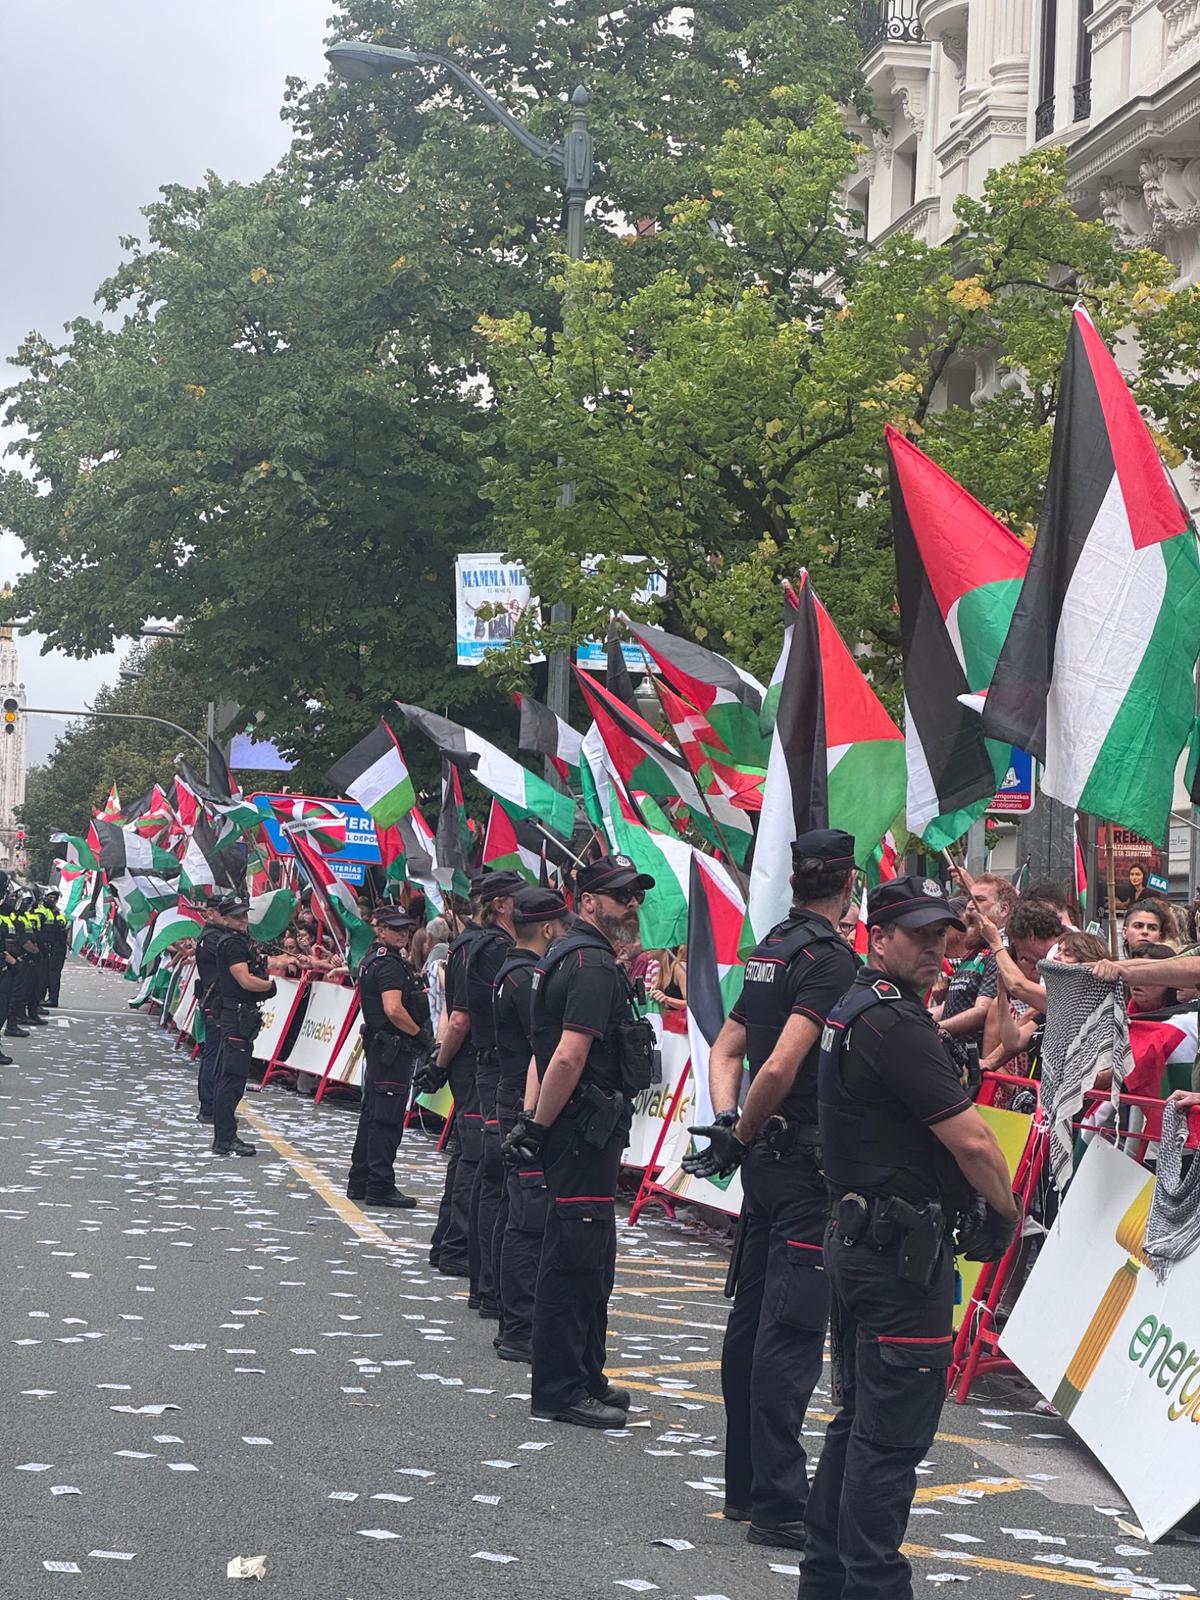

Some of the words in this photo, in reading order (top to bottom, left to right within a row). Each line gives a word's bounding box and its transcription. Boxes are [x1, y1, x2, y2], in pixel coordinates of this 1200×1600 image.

[462, 569, 506, 588] MAMMA
[353, 834, 378, 844] DEPO
[329, 864, 362, 873] OTERÍAS
